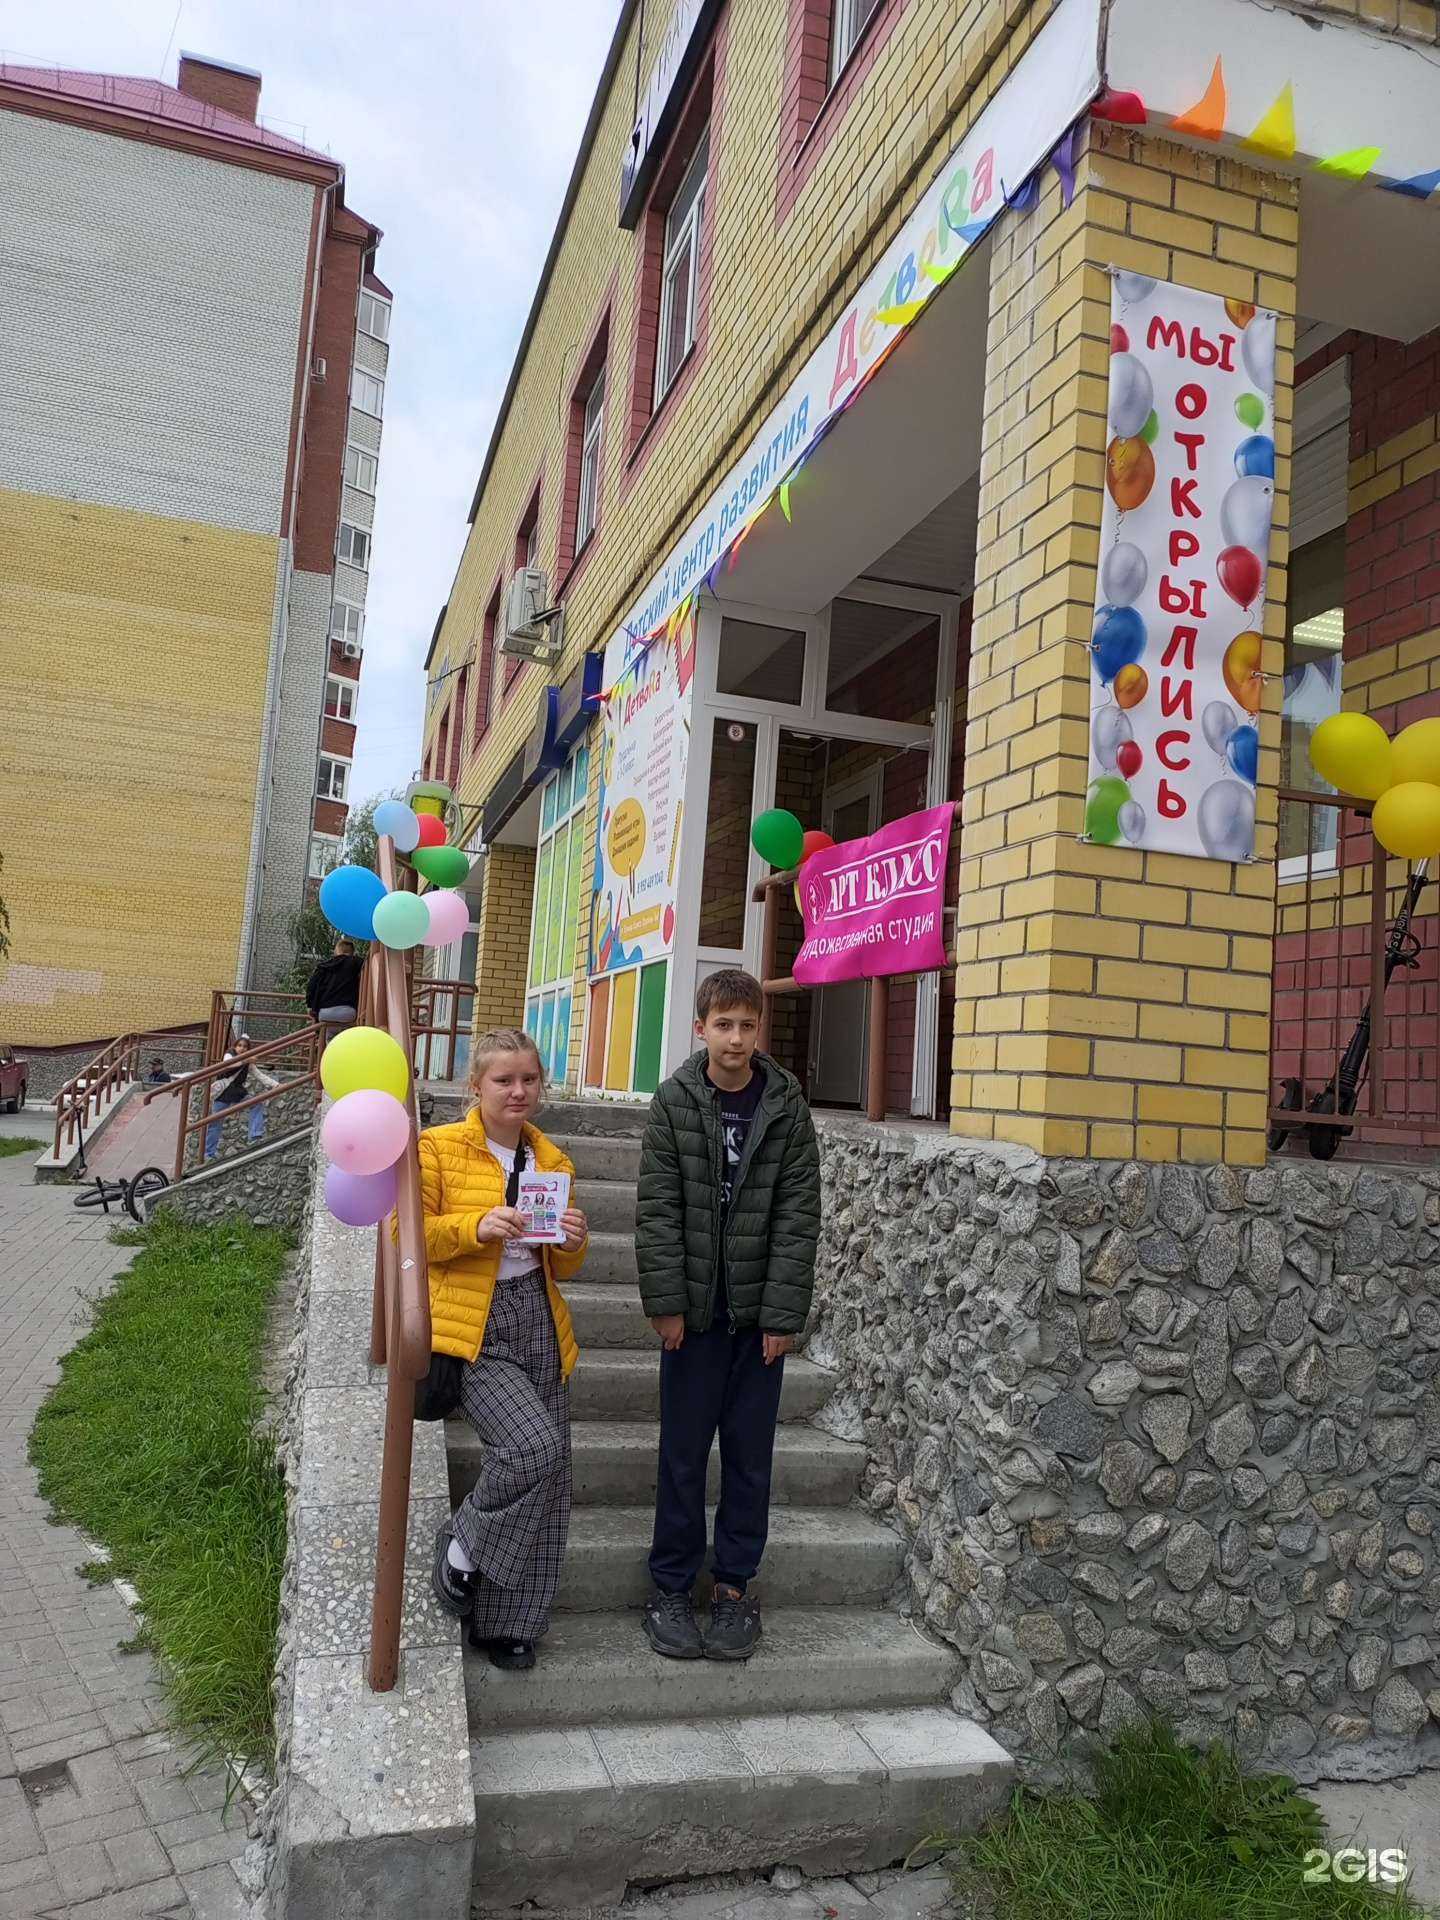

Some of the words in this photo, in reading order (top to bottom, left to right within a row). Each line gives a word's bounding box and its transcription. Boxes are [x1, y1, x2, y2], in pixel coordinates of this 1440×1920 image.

[1146, 315, 1236, 373] МЫ
[672, 521, 714, 600] центр
[717, 394, 810, 554] развития
[1155, 382, 1208, 820] ОТКРЫЛИСЬ
[827, 868, 859, 913] АРТ
[864, 838, 942, 902] КЛАСС
[802, 922, 885, 962] удожественная
[888, 911, 935, 945] студия
